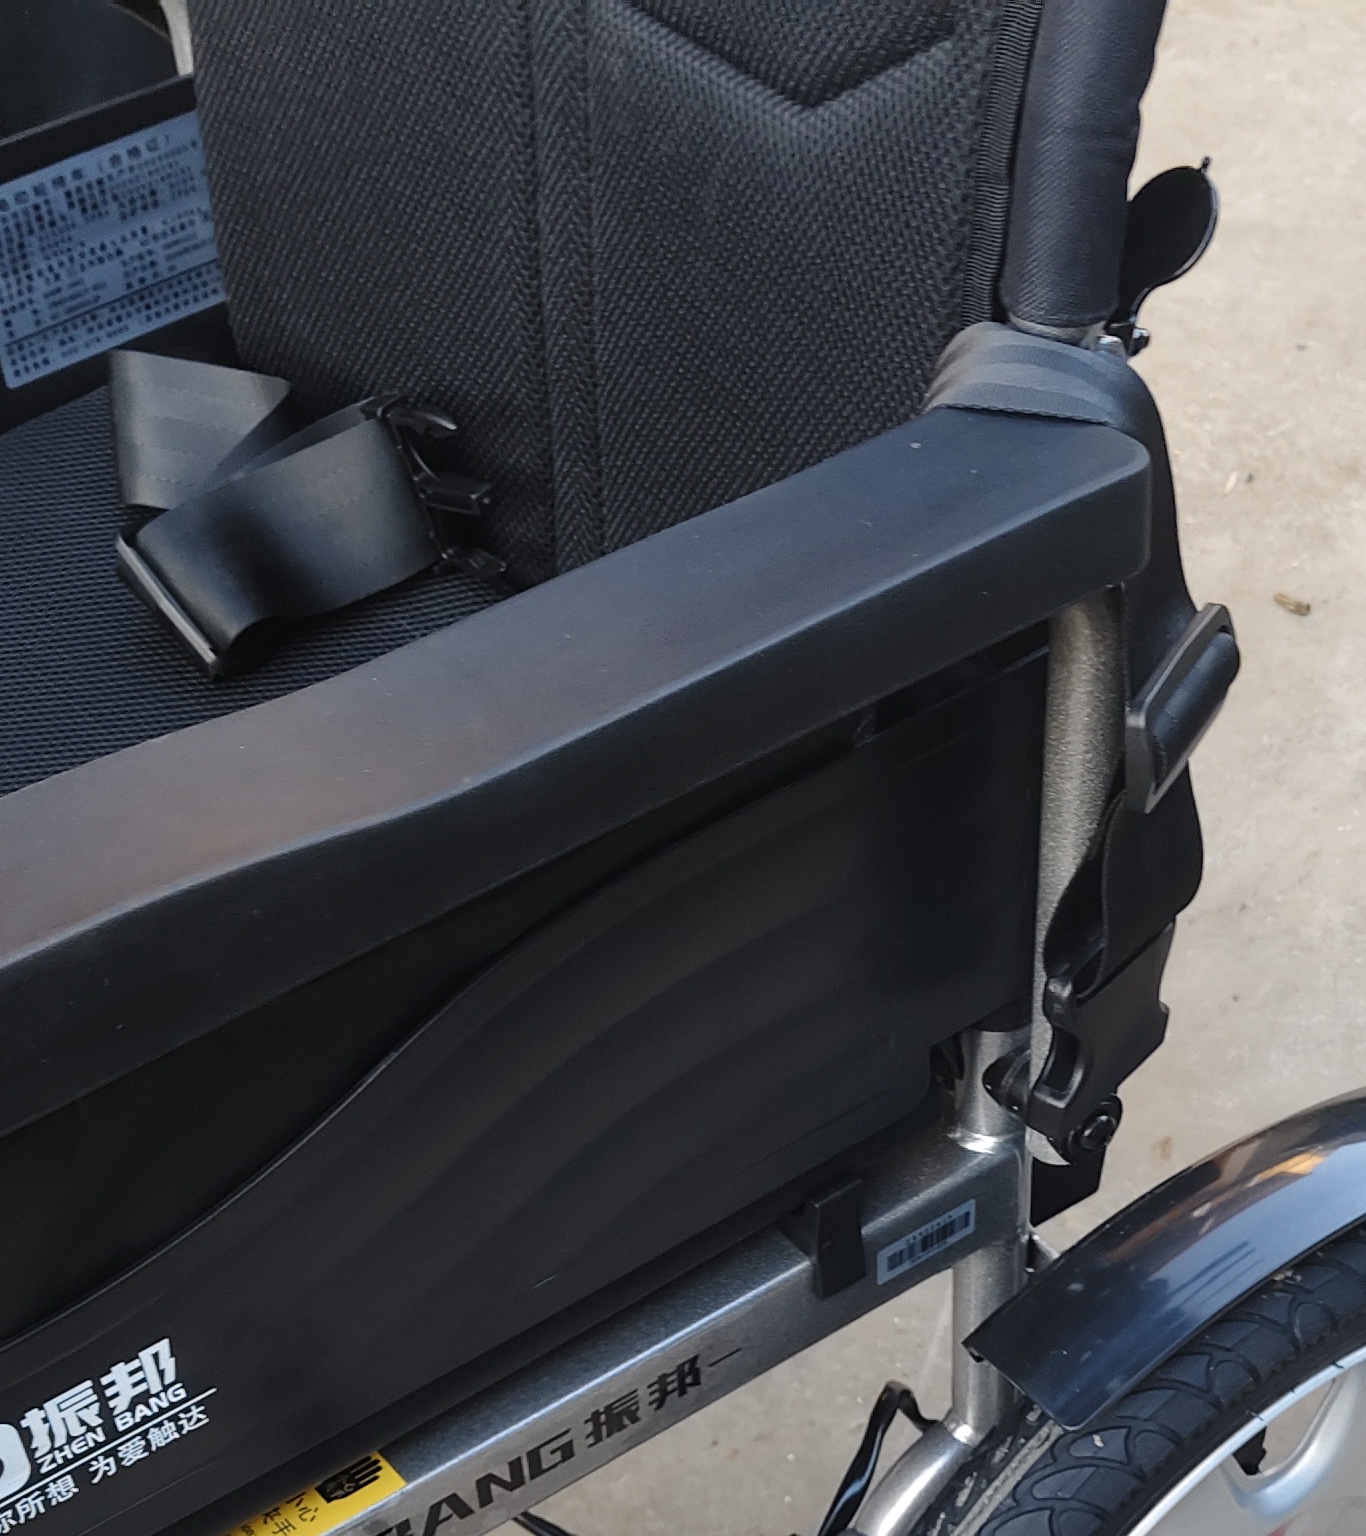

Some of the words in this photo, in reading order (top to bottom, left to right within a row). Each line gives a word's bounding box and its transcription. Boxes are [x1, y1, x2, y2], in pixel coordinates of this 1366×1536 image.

[21, 1338, 176, 1453] 振邦
[37, 1428, 105, 1474] ZHEN
[115, 1383, 187, 1432] BANG
[584, 1354, 703, 1450] 振邦
[89, 1405, 211, 1486] 为爱触达
